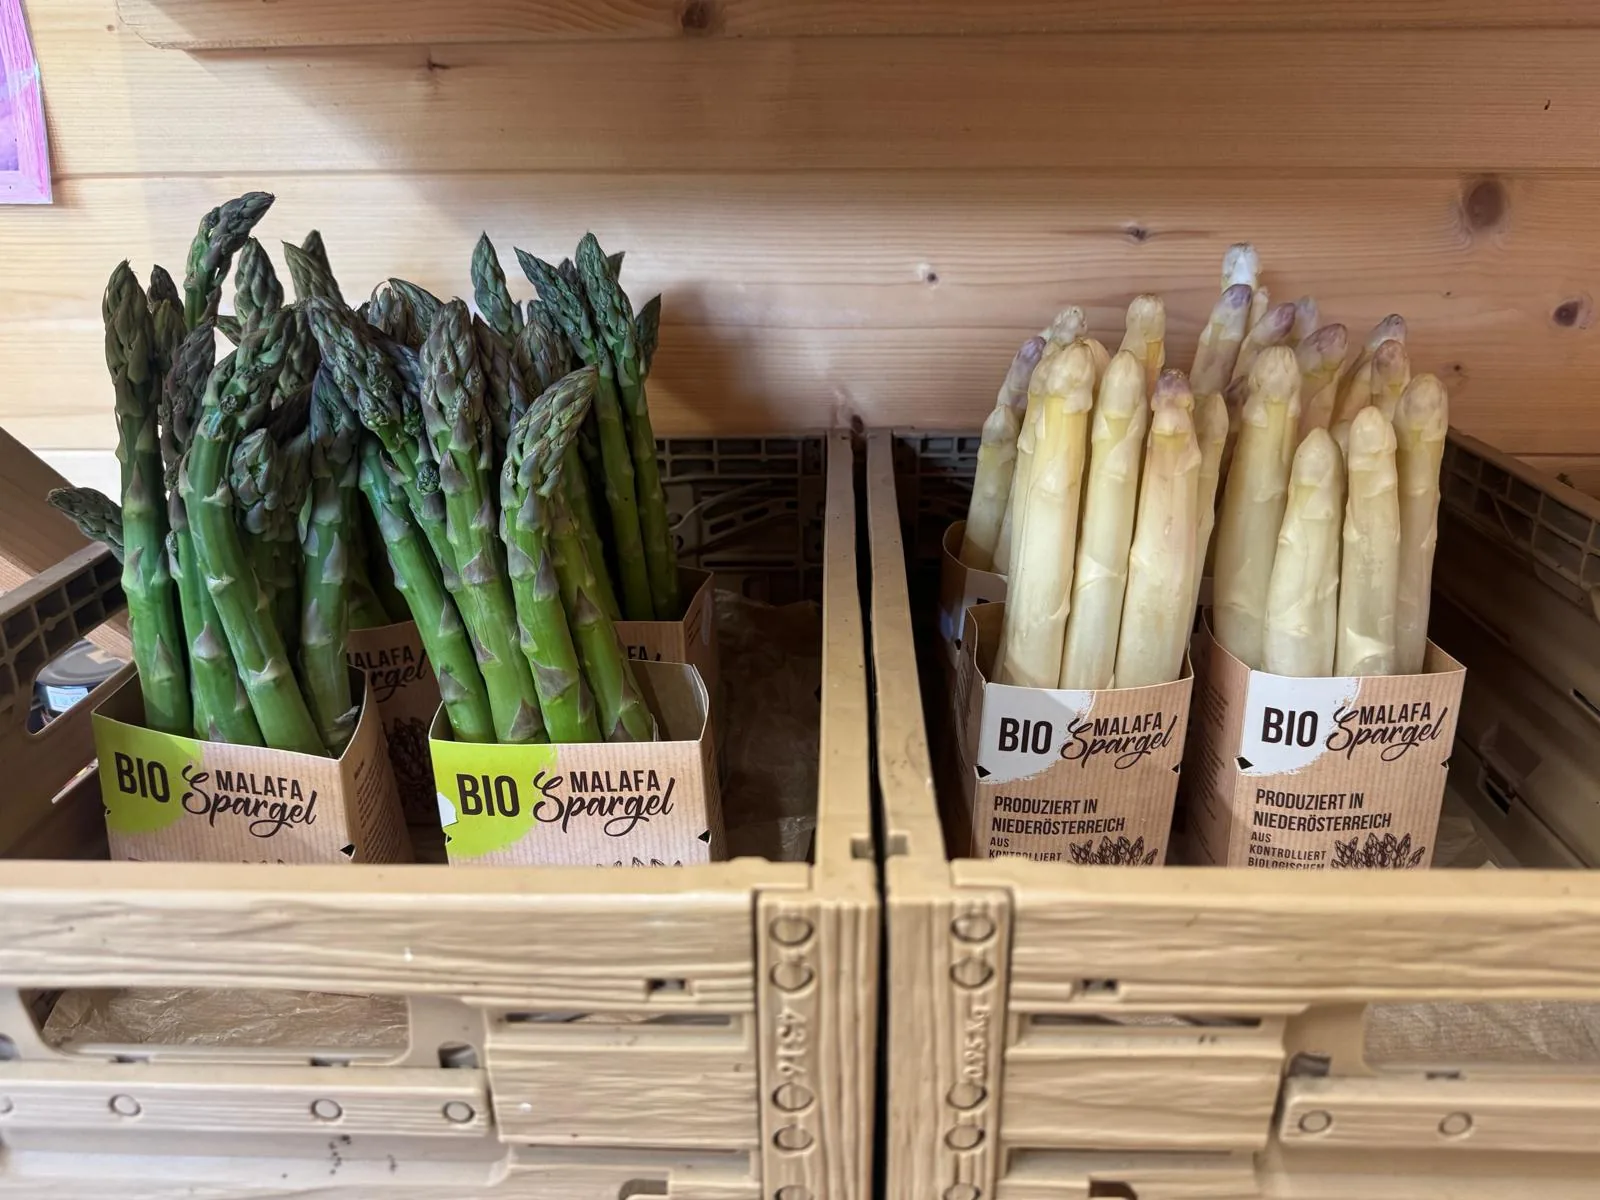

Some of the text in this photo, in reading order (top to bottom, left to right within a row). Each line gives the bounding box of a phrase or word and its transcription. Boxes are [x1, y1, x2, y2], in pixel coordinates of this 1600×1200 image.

[1093, 712, 1163, 737] MALAFA
[1359, 702, 1432, 725] MALAFA
[998, 717, 1053, 755] BIO
[1261, 706, 1319, 748] BIO
[1326, 706, 1448, 761] Spargel
[1060, 715, 1178, 770] Spargel
[114, 752, 170, 803] BIO
[215, 769, 304, 801] MALAFA
[570, 769, 661, 793] MALAFA
[181, 764, 318, 837] Spargel
[456, 773, 521, 817] BIO
[532, 770, 676, 837] Spargel
[993, 795, 1098, 815] PRODUZIERT IN
[1256, 788, 1364, 811] PRODUZIERT IN
[991, 816, 1126, 835] NIEDERÖSTERREICH
[1253, 810, 1393, 832] NIEDERÖSTERREICH
[989, 836, 1010, 848] AUS
[1250, 831, 1272, 843] AUS
[1249, 843, 1327, 861] KONTROLLIERT
